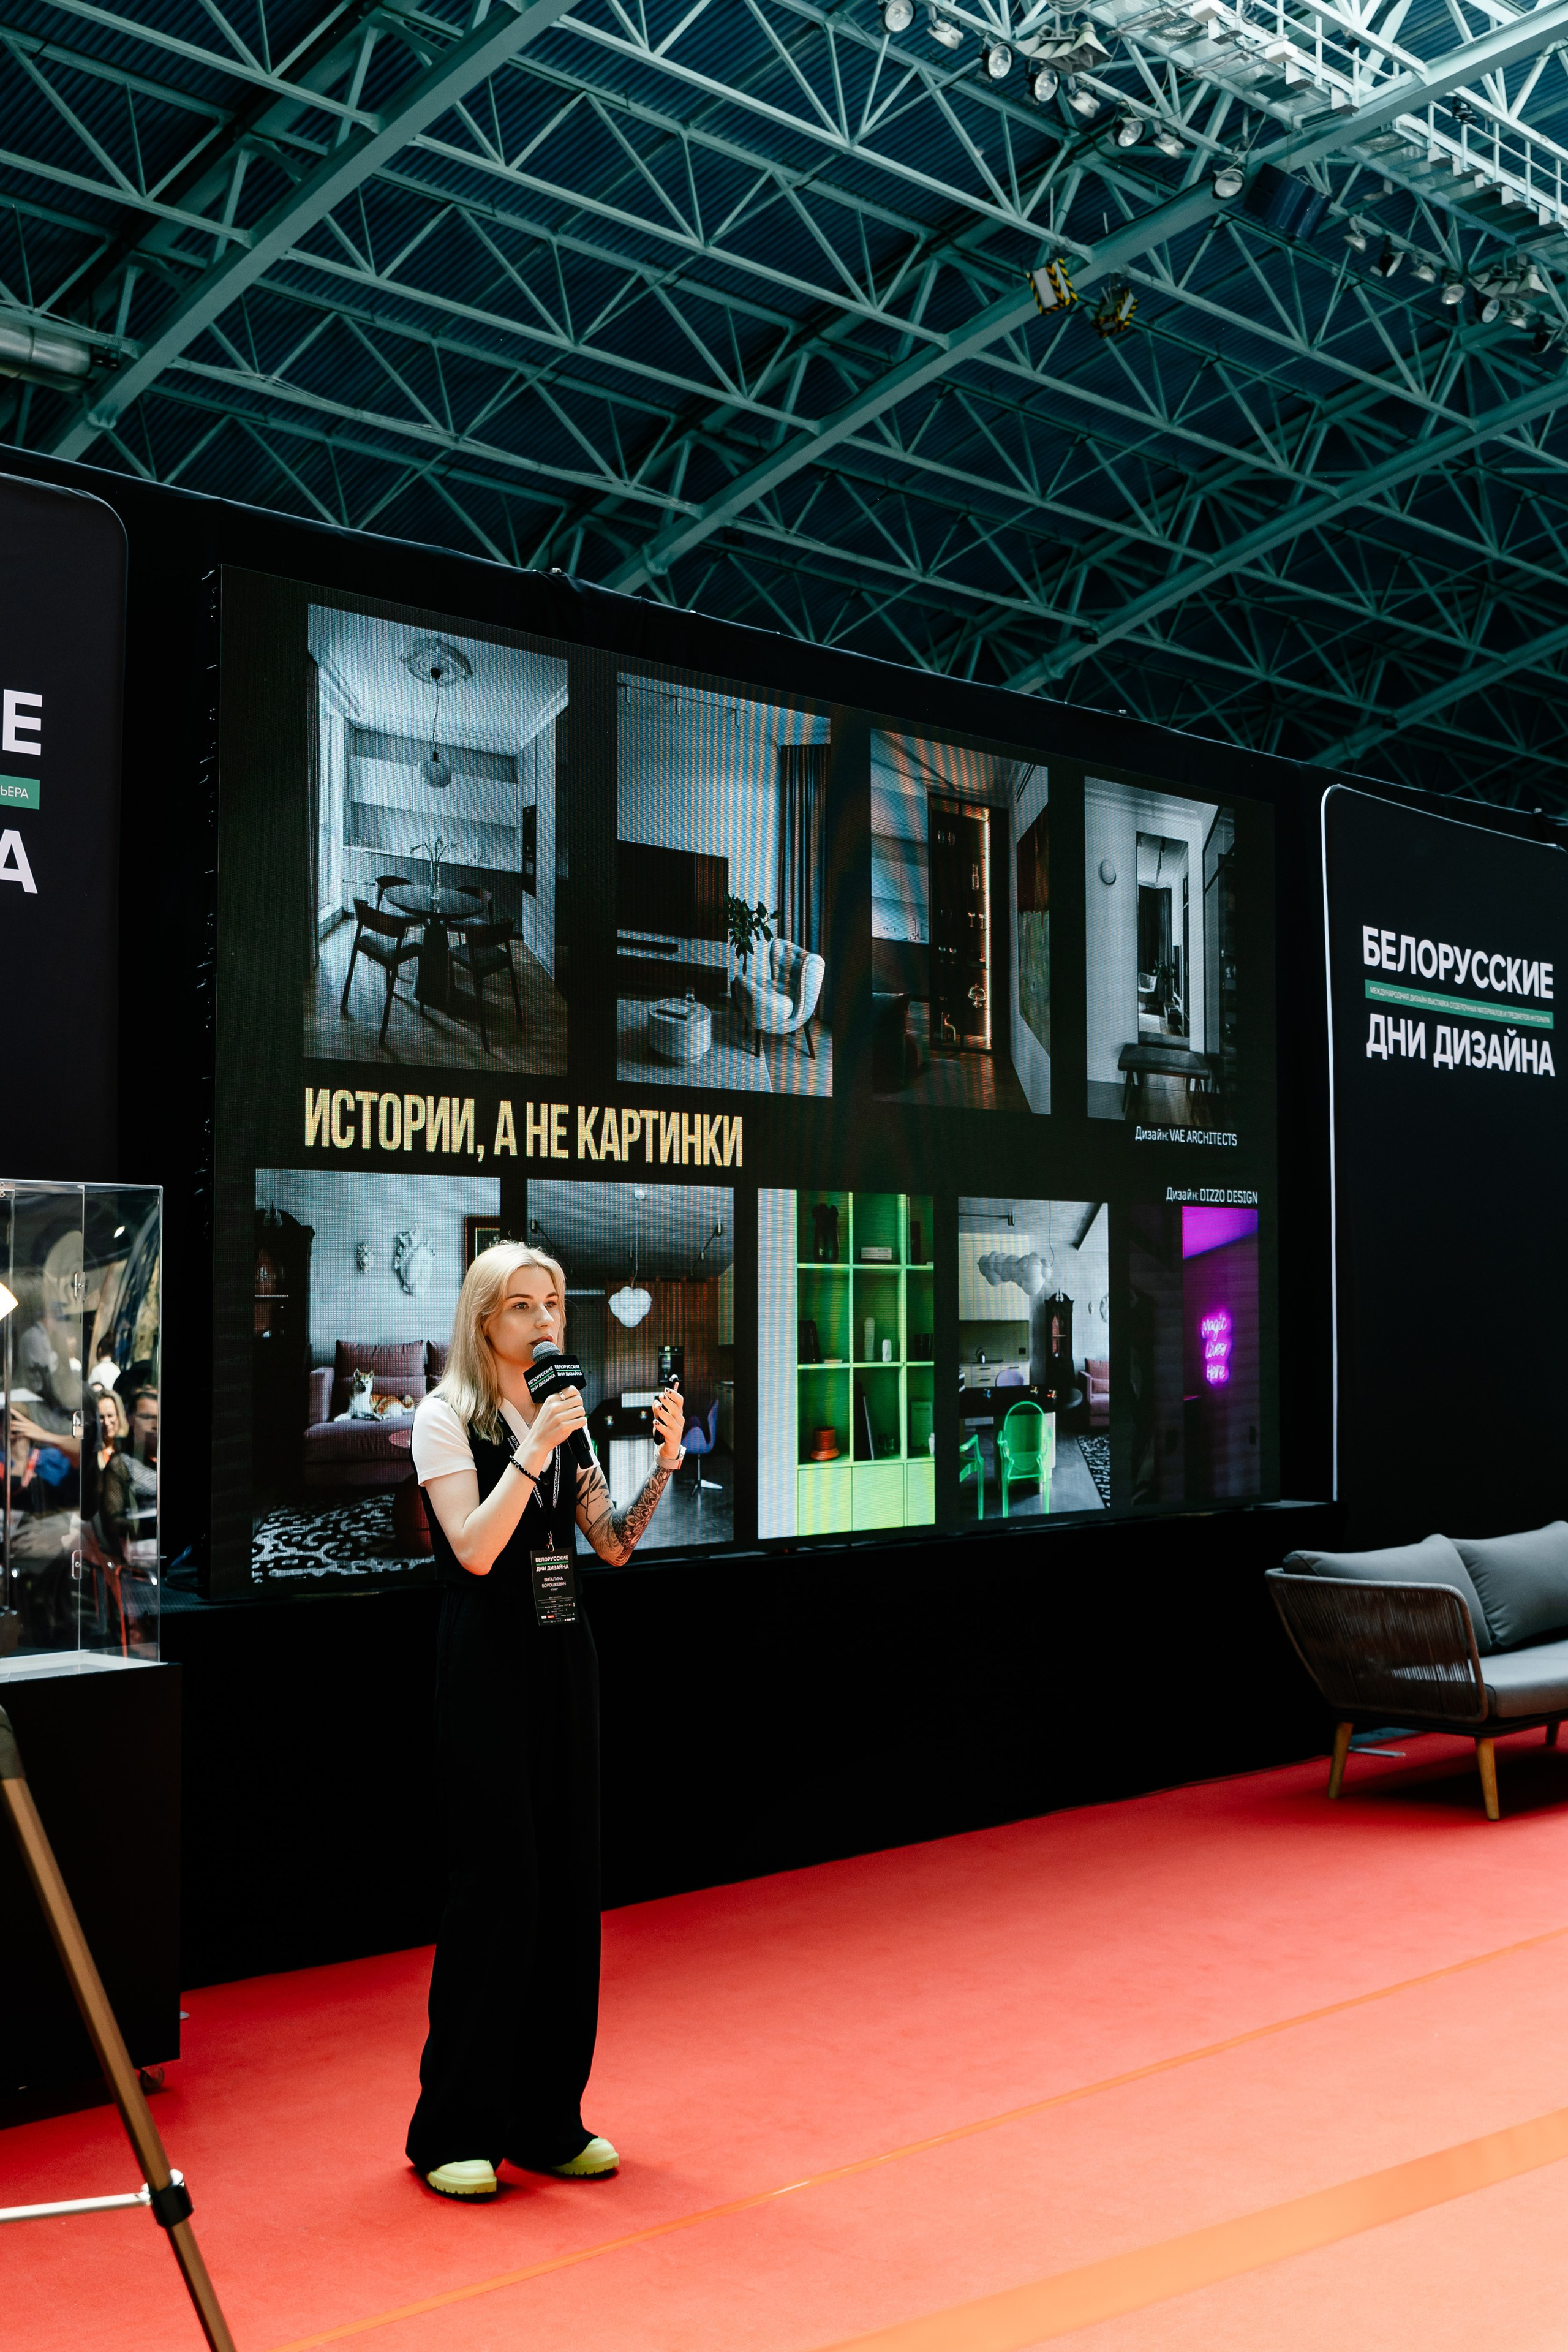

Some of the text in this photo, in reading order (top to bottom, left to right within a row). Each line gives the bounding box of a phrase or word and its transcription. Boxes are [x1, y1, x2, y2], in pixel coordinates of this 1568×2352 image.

[1363, 925, 1554, 999] БЕЛОРУССКИЕ
[1366, 1013, 1556, 1077] ДНИ ДИЗАЙНА
[304, 1087, 744, 1168] ИСТОРИИ, А НЕ КАРТИНКИ
[1135, 1126, 1237, 1146] Дизайн: VAE ARCHITECTS
[1166, 1187, 1258, 1204] Дизайн: DIZZO DESIGN
[527, 1366, 554, 1385] БЕЛОРУССКИЕ
[538, 1374, 556, 1387] ДИЗАЙНА
